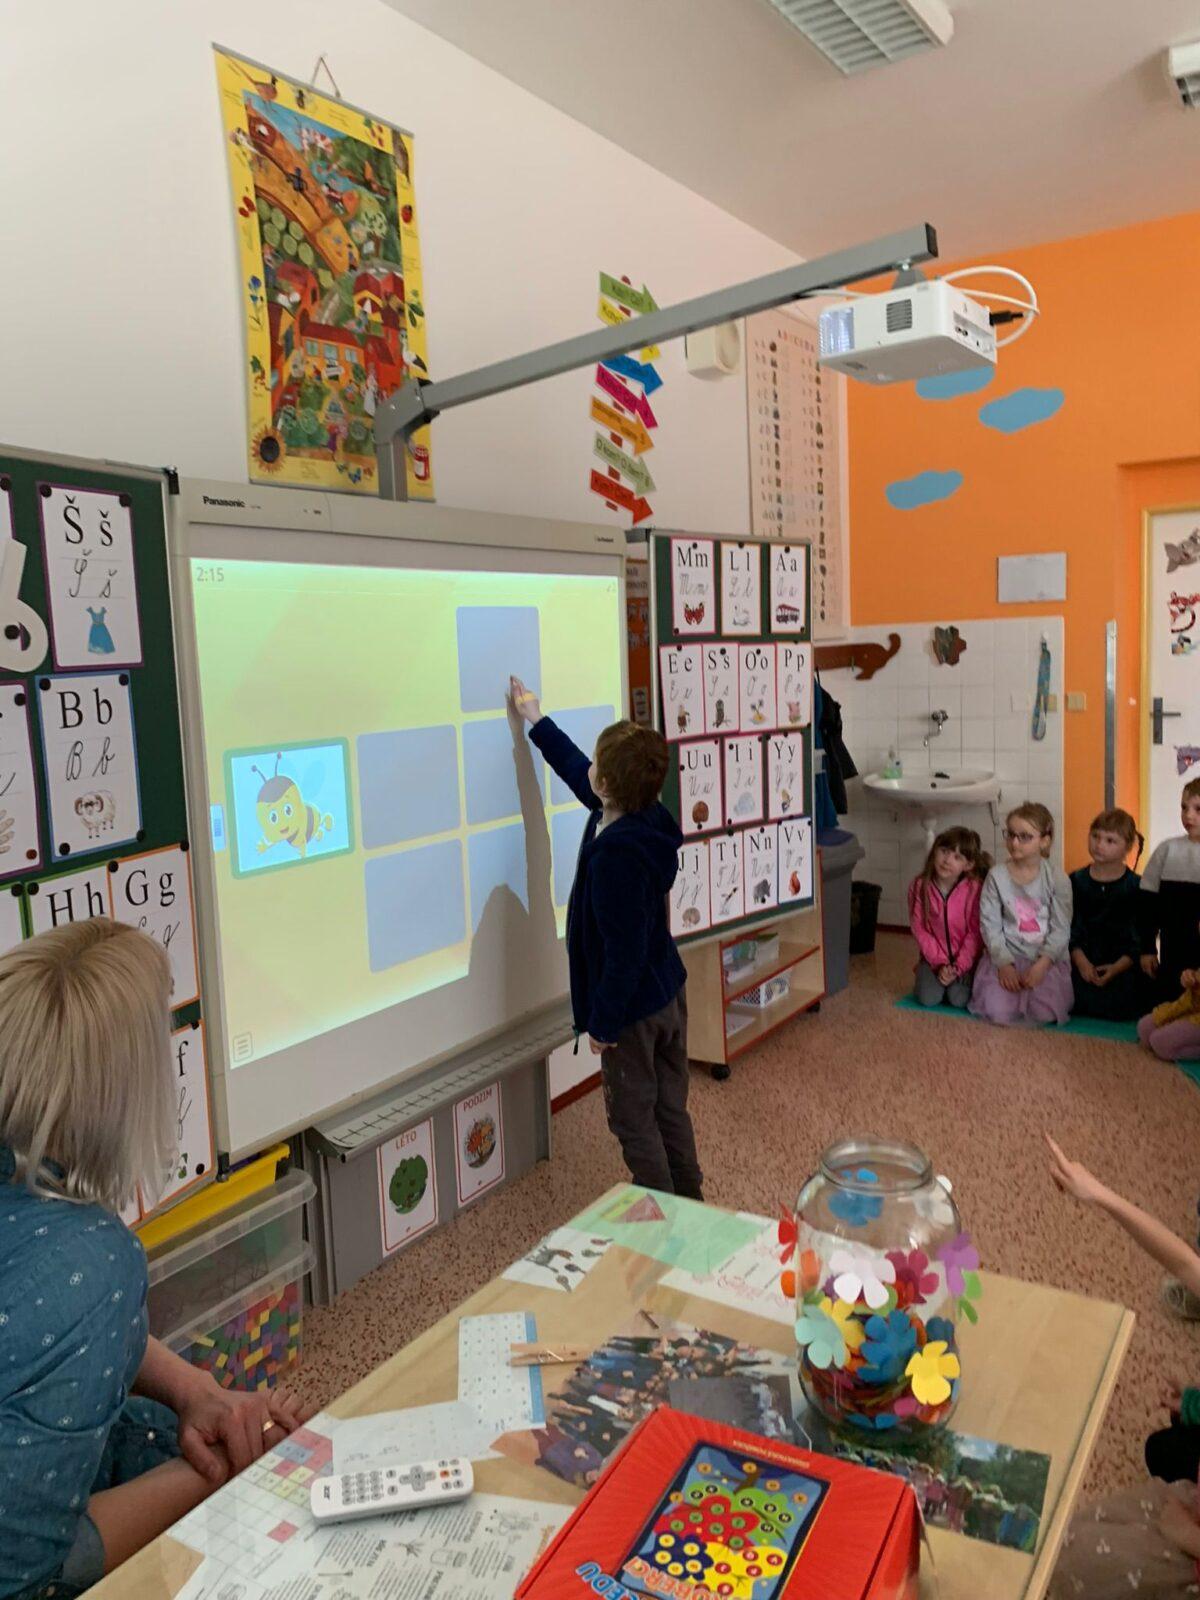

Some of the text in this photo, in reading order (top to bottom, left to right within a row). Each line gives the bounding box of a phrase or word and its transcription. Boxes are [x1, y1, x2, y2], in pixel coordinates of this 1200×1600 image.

[203, 496, 245, 508] Panasonic
[63, 494, 113, 547] Š š
[196, 567, 224, 582] 2:15
[668, 654, 693, 674] E e
[57, 687, 113, 729] B b
[687, 751, 712, 770] U u
[125, 869, 176, 907] G g
[46, 881, 106, 927] H h
[176, 1040, 189, 1078] f
[463, 1088, 493, 1111] PODZIM
